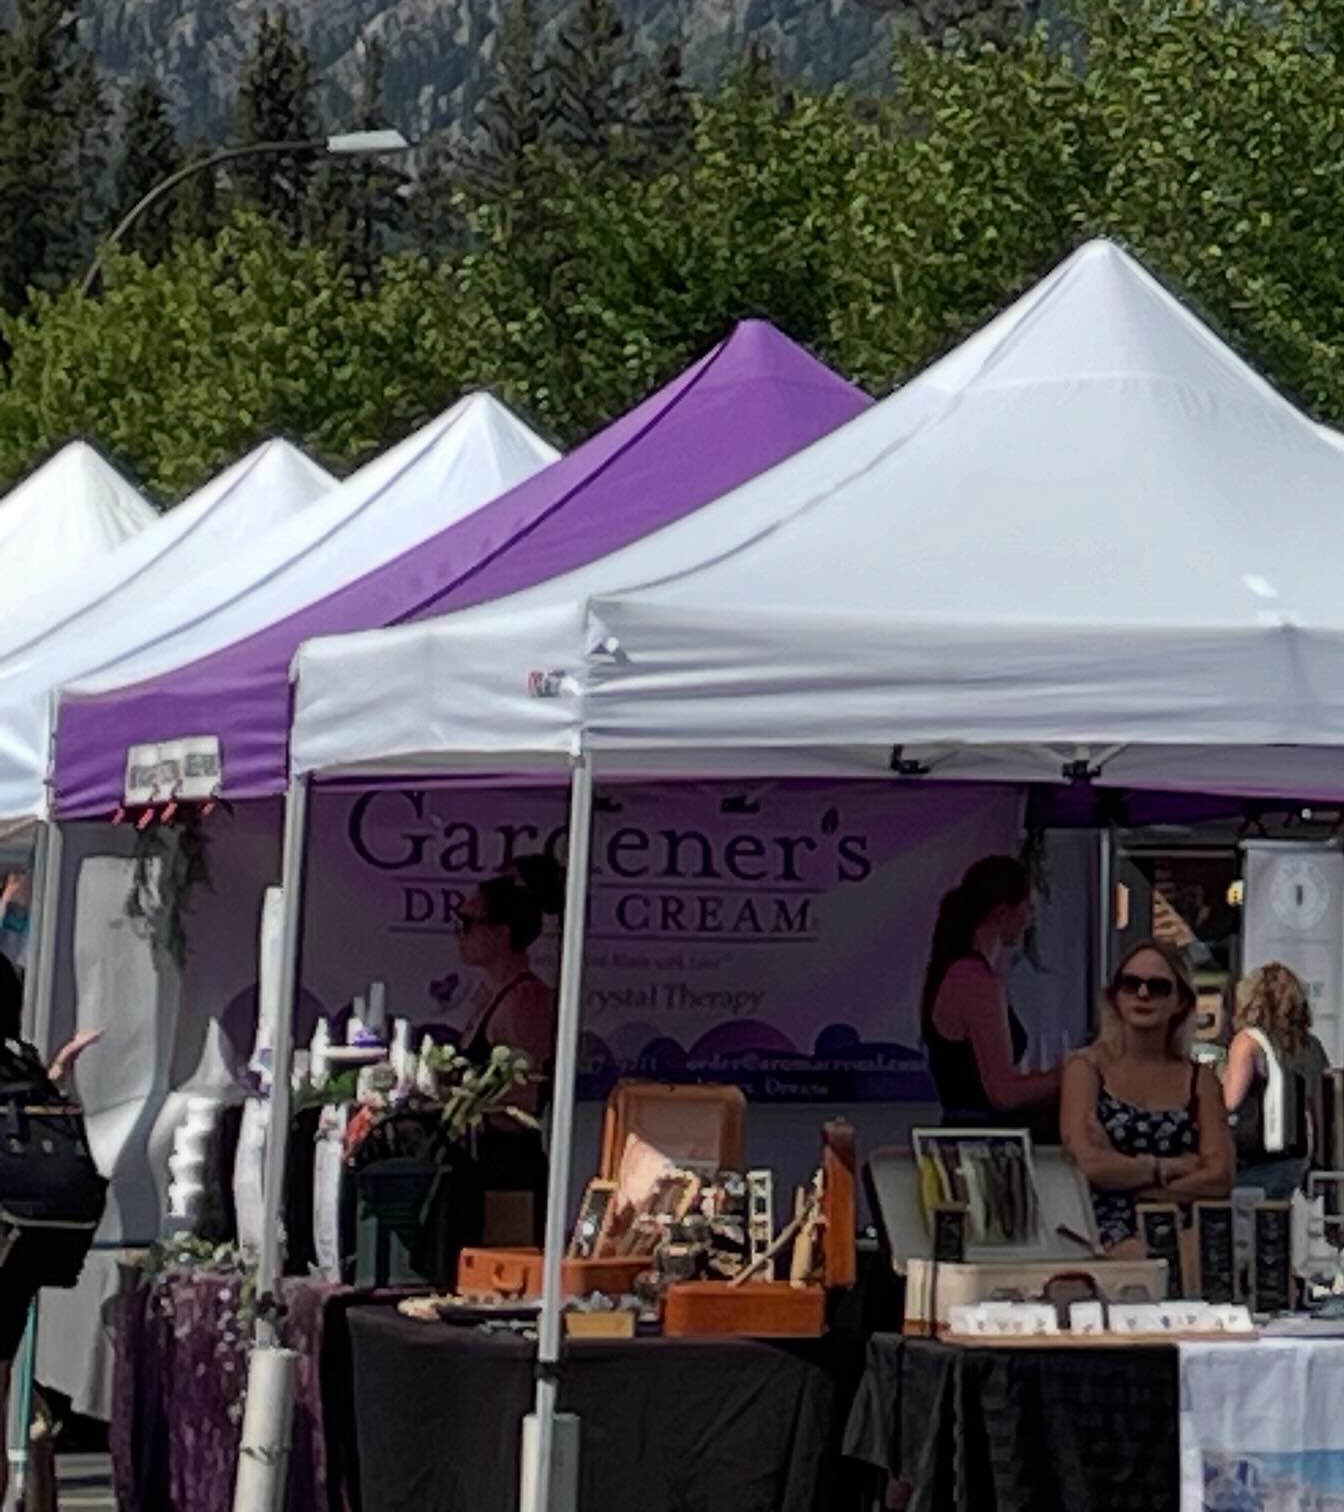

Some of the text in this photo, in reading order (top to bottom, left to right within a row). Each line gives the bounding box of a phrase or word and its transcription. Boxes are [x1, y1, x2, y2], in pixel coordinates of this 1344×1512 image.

[615, 893, 812, 934] CREAM
[585, 982, 768, 1016] rystal Therapy
